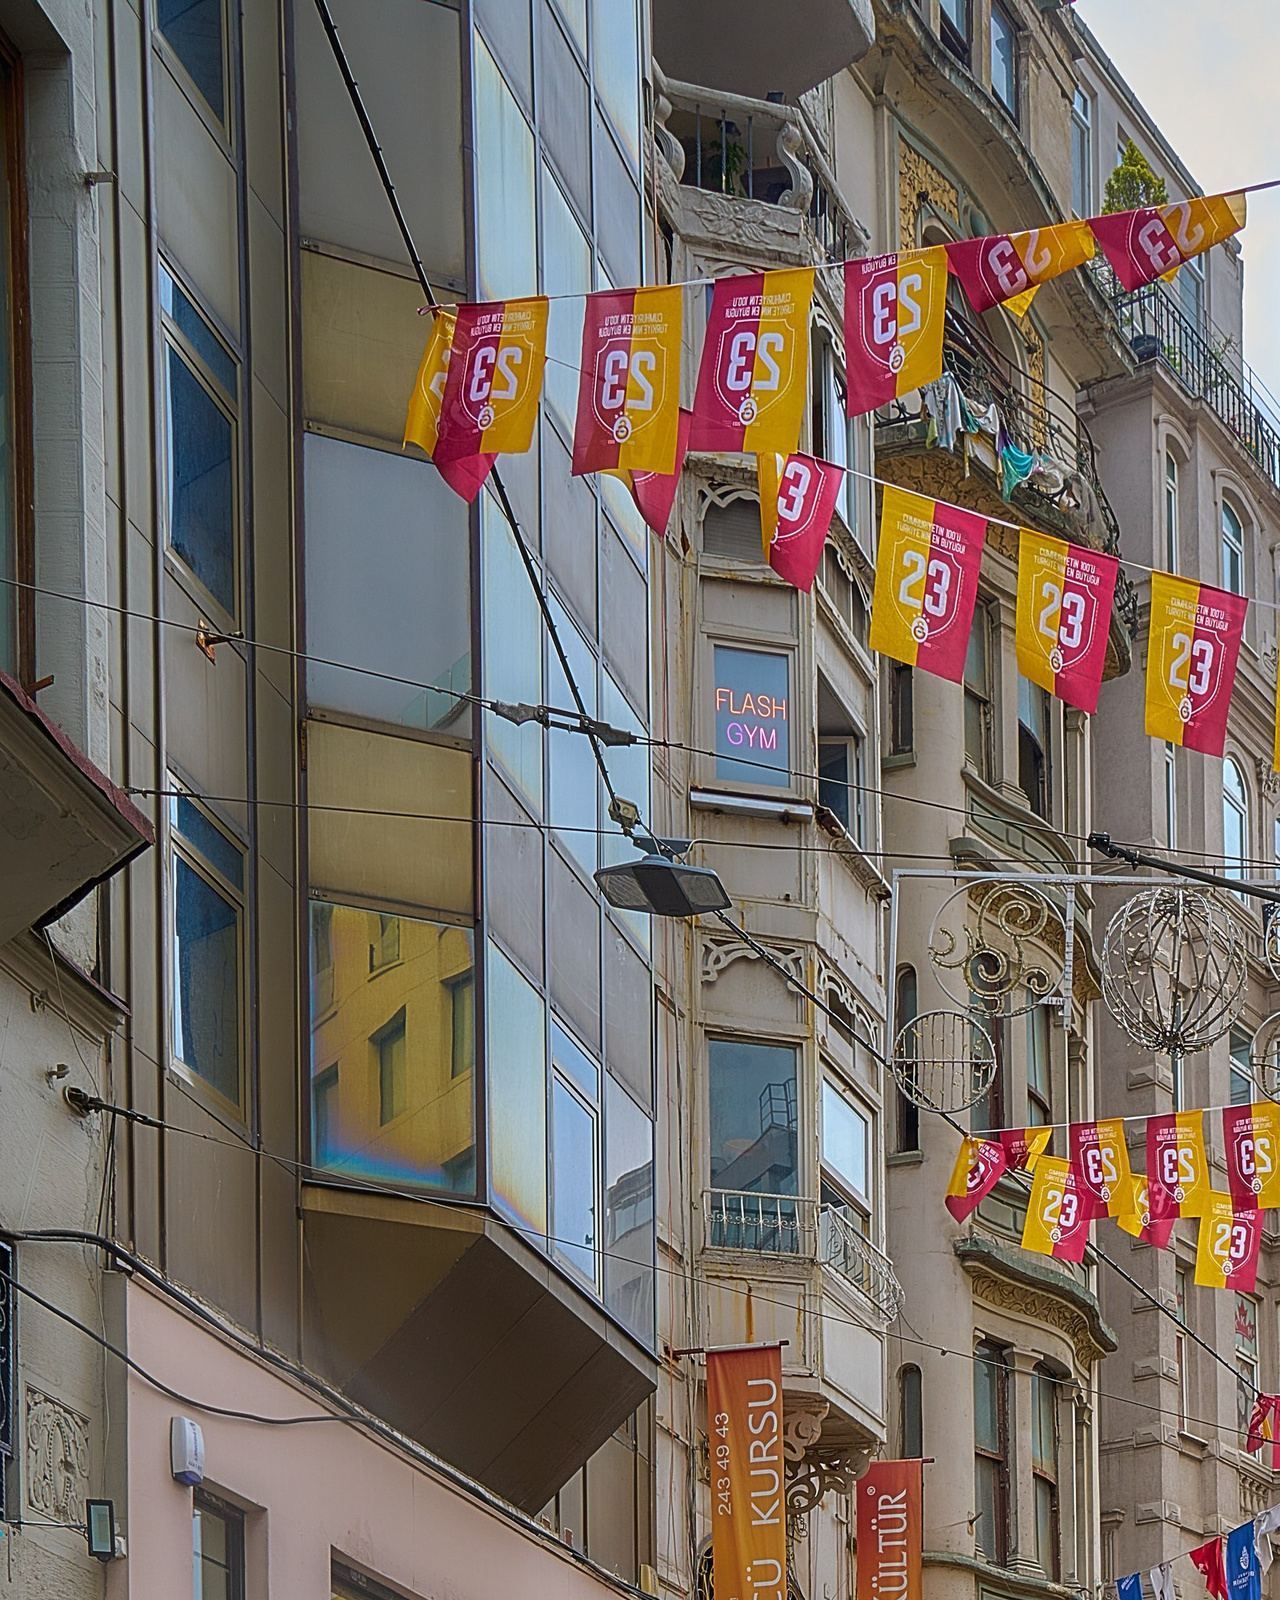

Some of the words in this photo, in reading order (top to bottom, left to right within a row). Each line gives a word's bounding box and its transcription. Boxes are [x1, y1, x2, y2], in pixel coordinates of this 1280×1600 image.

[778, 462, 811, 521] 3
[899, 550, 950, 617] 23
[1039, 582, 1085, 648] 23
[1169, 633, 1213, 695] 23
[715, 688, 787, 721] FLASH
[726, 721, 778, 751] GYM
[1043, 1190, 1077, 1227] 23
[1214, 1224, 1246, 1258] 23
[715, 1411, 730, 1438] 43
[716, 1444, 731, 1470] 49
[748, 1377, 781, 1526] KURSU
[716, 1476, 731, 1516] 243
